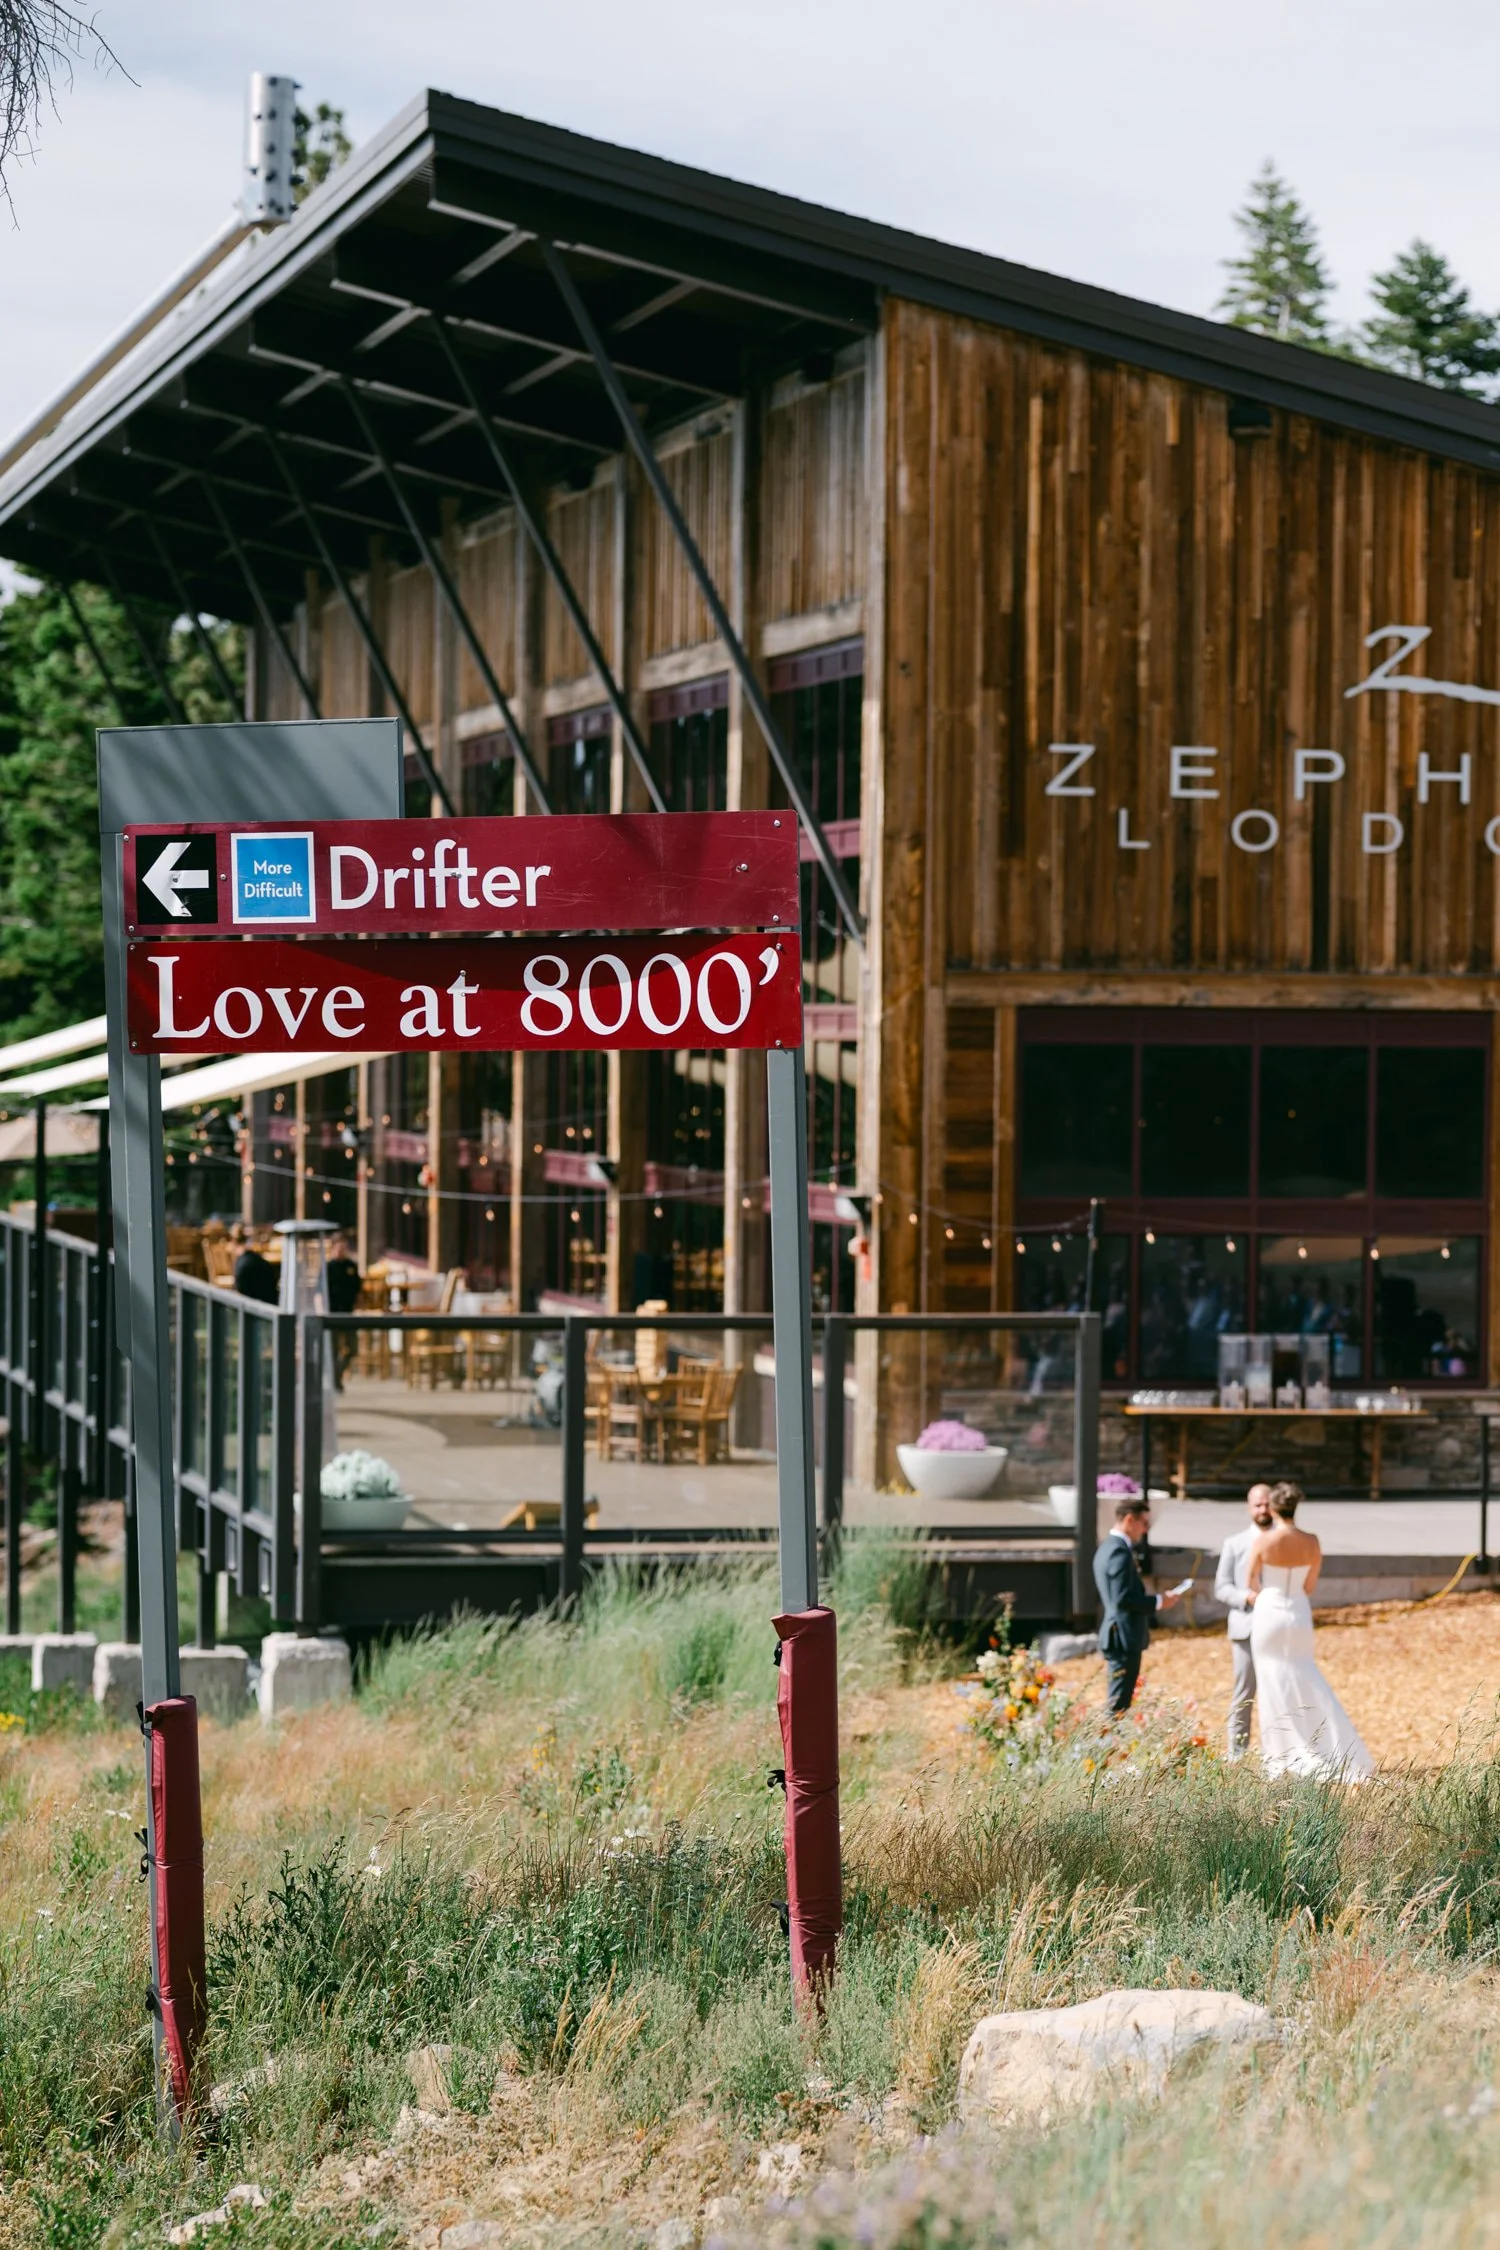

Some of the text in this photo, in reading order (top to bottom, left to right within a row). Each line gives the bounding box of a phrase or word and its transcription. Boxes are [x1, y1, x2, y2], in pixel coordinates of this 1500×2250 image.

[253, 860, 293, 875] More
[330, 839, 551, 910] Drifter
[244, 882, 303, 898] Difficult
[147, 956, 366, 1040] Love
[400, 973, 482, 1038] at
